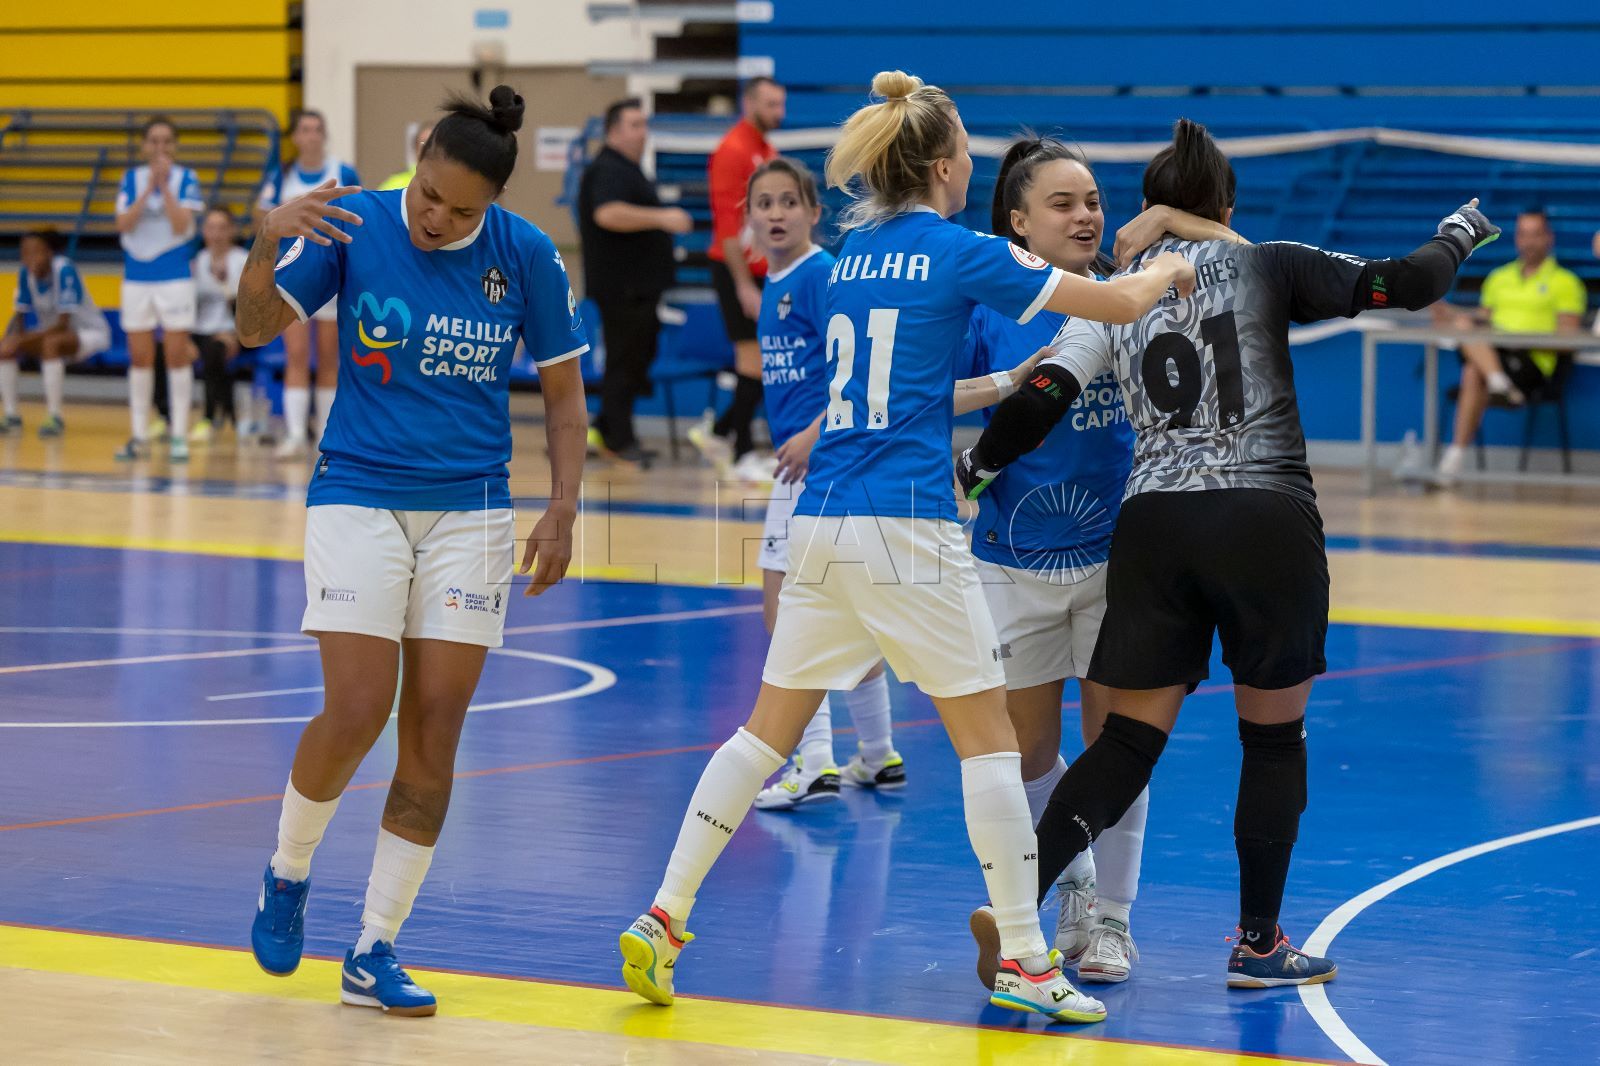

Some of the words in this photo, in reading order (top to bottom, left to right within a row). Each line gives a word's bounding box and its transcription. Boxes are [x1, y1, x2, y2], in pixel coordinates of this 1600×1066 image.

[425, 313, 513, 343] MELILLA
[421, 336, 500, 364] SPORT
[419, 357, 497, 383] CAPITAL
[824, 308, 900, 432] 21
[1141, 310, 1245, 429] 91
[326, 593, 356, 603] MELILLA
[464, 604, 489, 612] CAPITAL
[465, 593, 490, 601] MELILLA
[465, 598, 486, 606] SPORT
